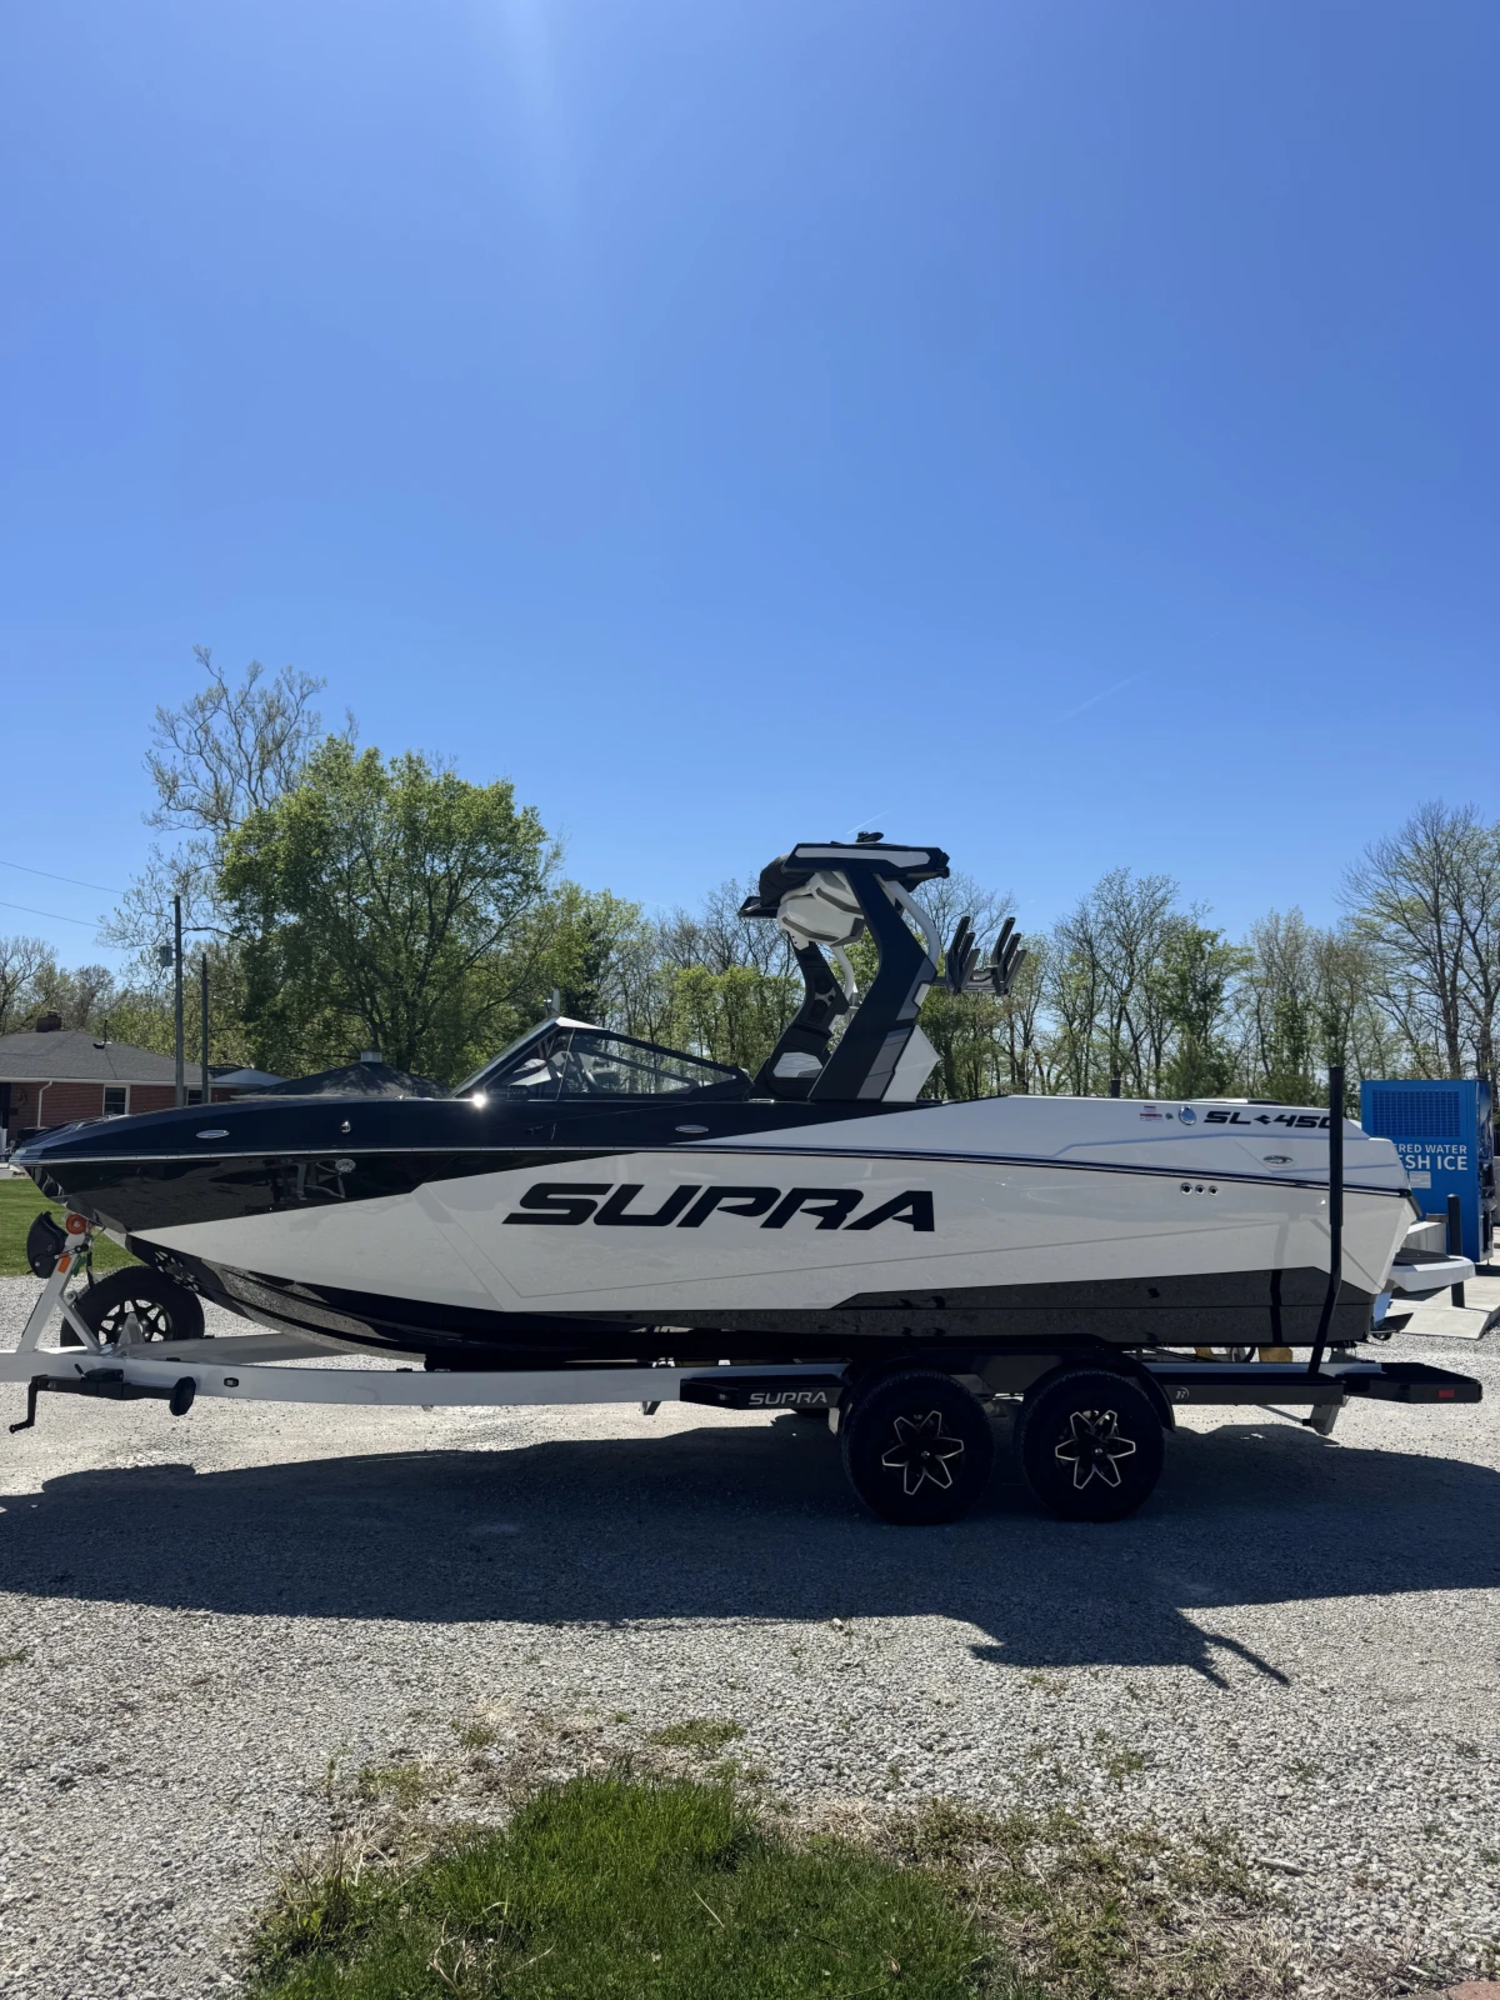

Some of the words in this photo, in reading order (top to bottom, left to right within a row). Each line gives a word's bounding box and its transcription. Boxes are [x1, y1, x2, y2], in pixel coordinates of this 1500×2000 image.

[1203, 1110, 1252, 1125] SL
[1425, 1144, 1467, 1155] WATER
[1437, 1155, 1468, 1171] ICE
[501, 1182, 935, 1232] SUPRA
[748, 1391, 828, 1406] SUPRA
